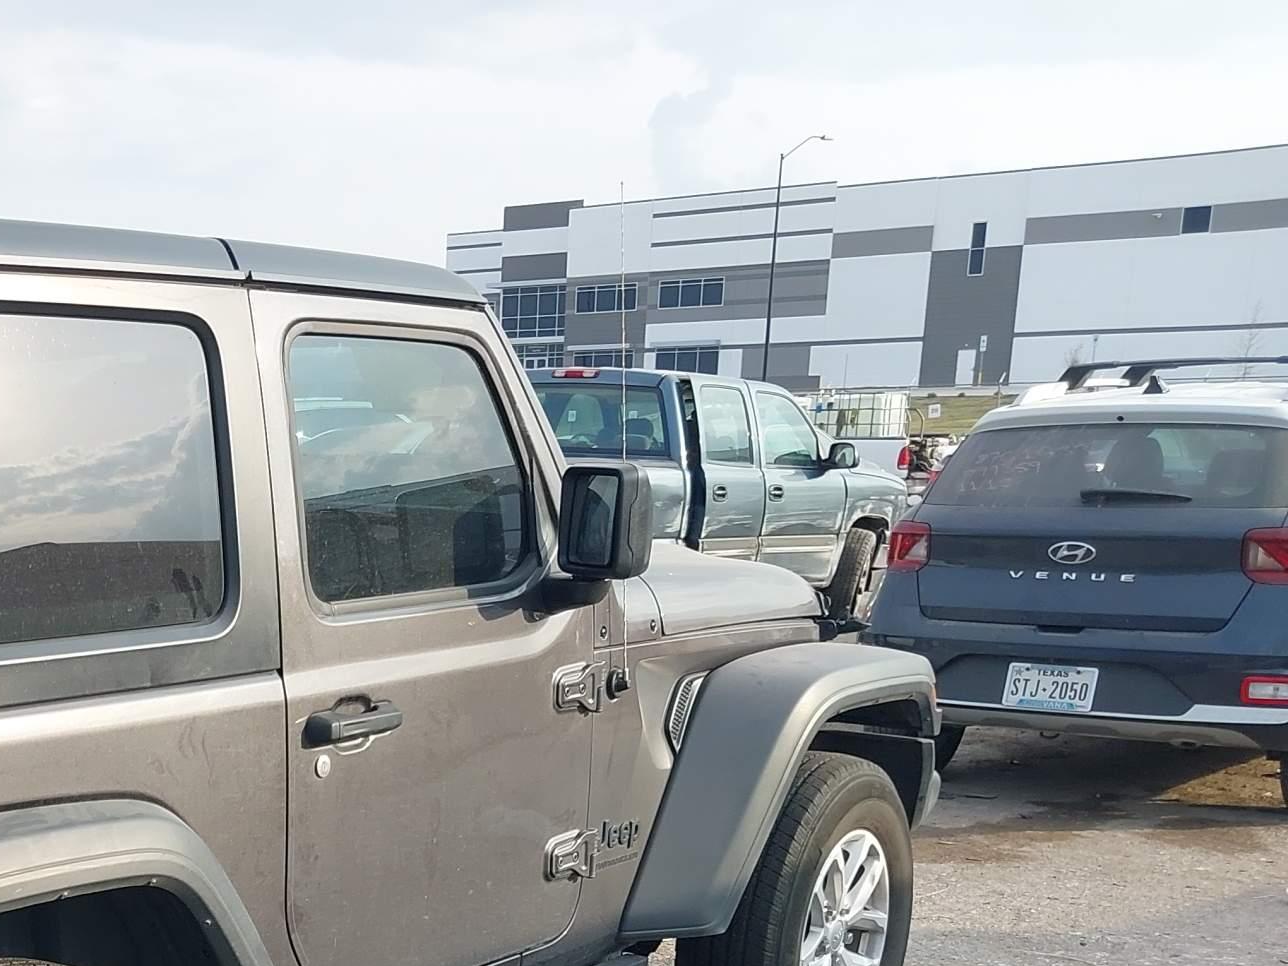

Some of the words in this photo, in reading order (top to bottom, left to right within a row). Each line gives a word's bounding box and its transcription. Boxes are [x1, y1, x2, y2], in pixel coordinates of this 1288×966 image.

[1009, 570, 1136, 582] VENUE
[1038, 669, 1069, 678] TEXAS
[600, 818, 639, 849] Jeep
